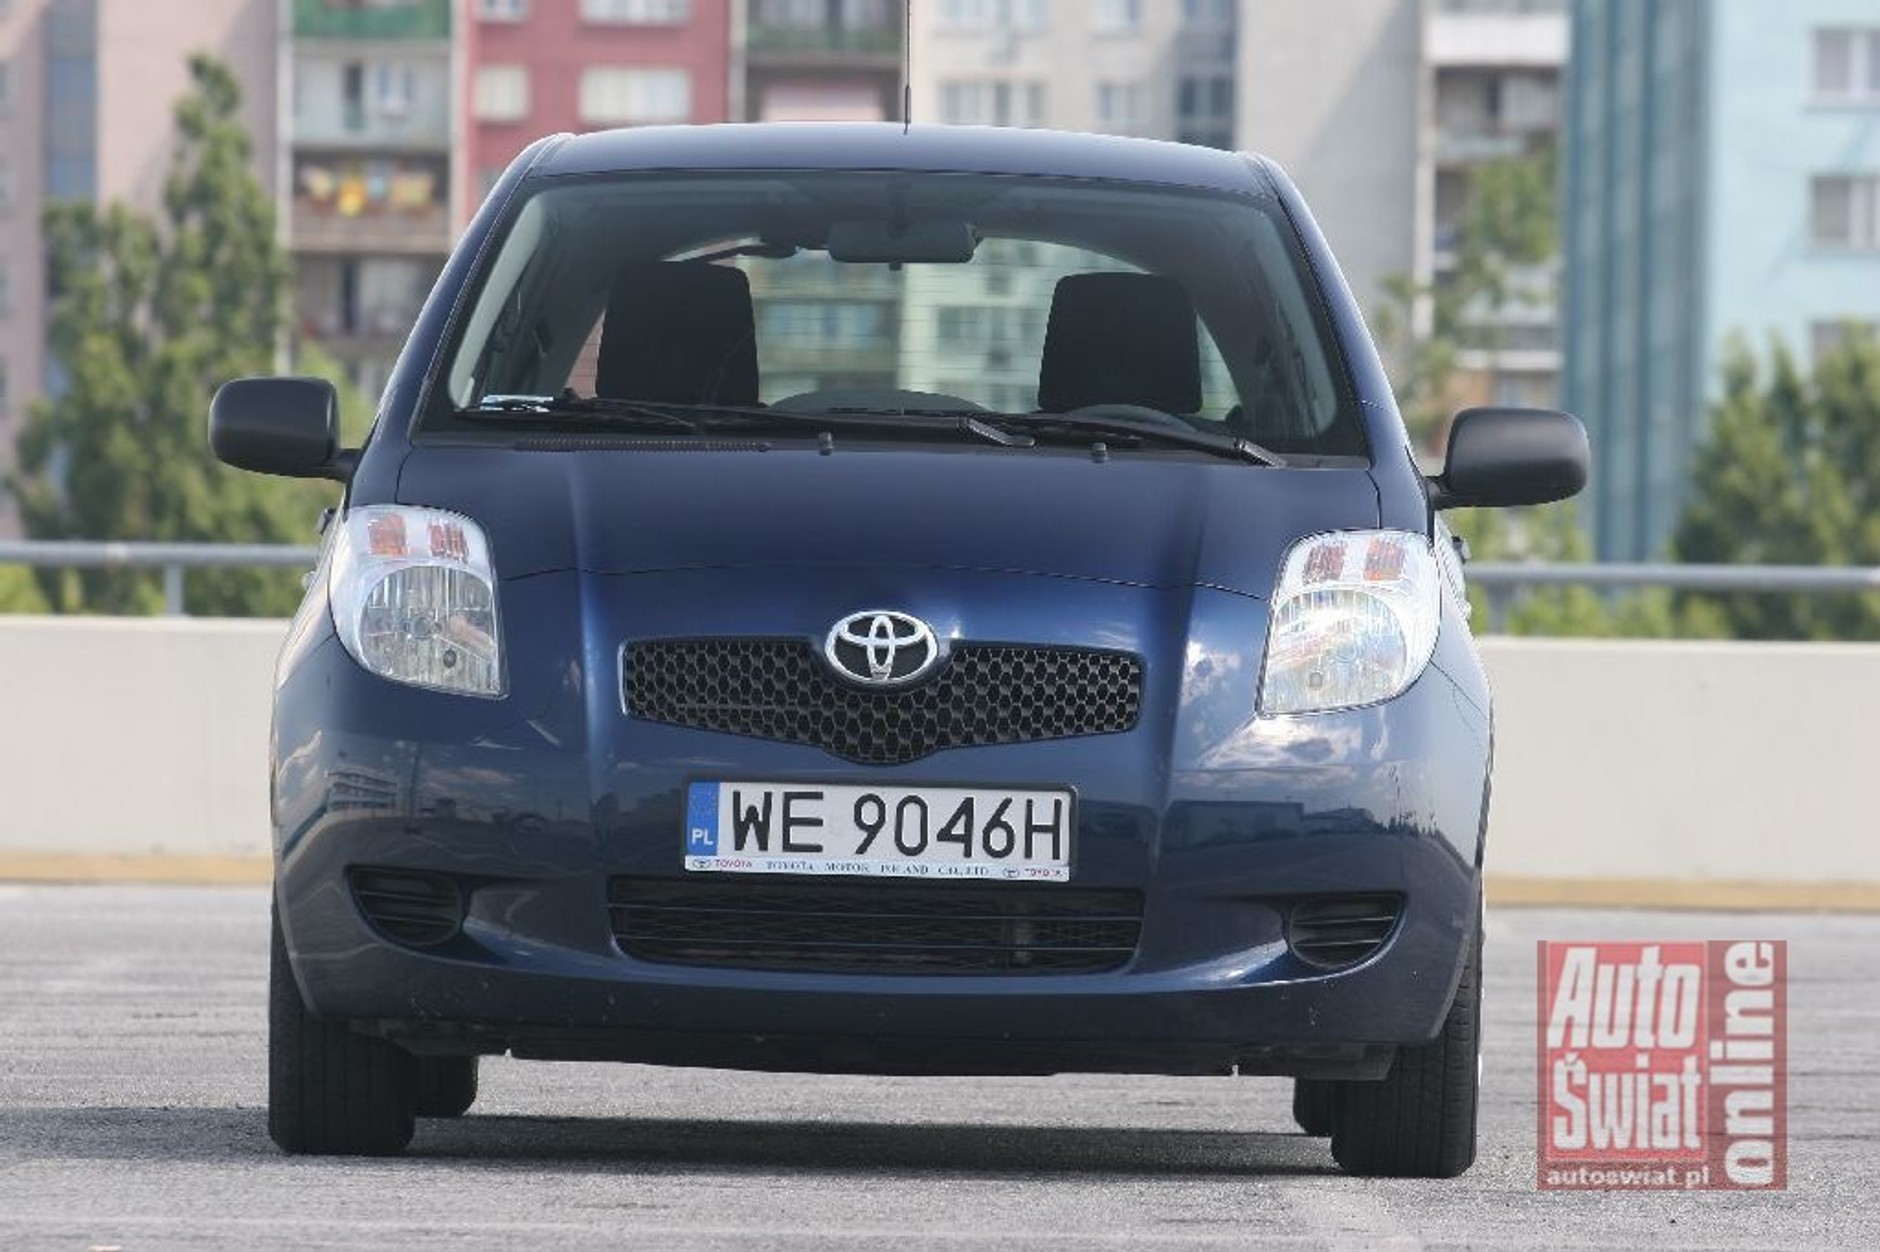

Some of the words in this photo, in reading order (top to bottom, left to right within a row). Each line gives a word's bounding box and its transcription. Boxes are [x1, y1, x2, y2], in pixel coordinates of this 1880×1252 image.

[732, 790, 824, 853] WE
[853, 792, 1062, 861] 9046H
[691, 829, 714, 847] PL
[715, 859, 753, 869] TOYOTA
